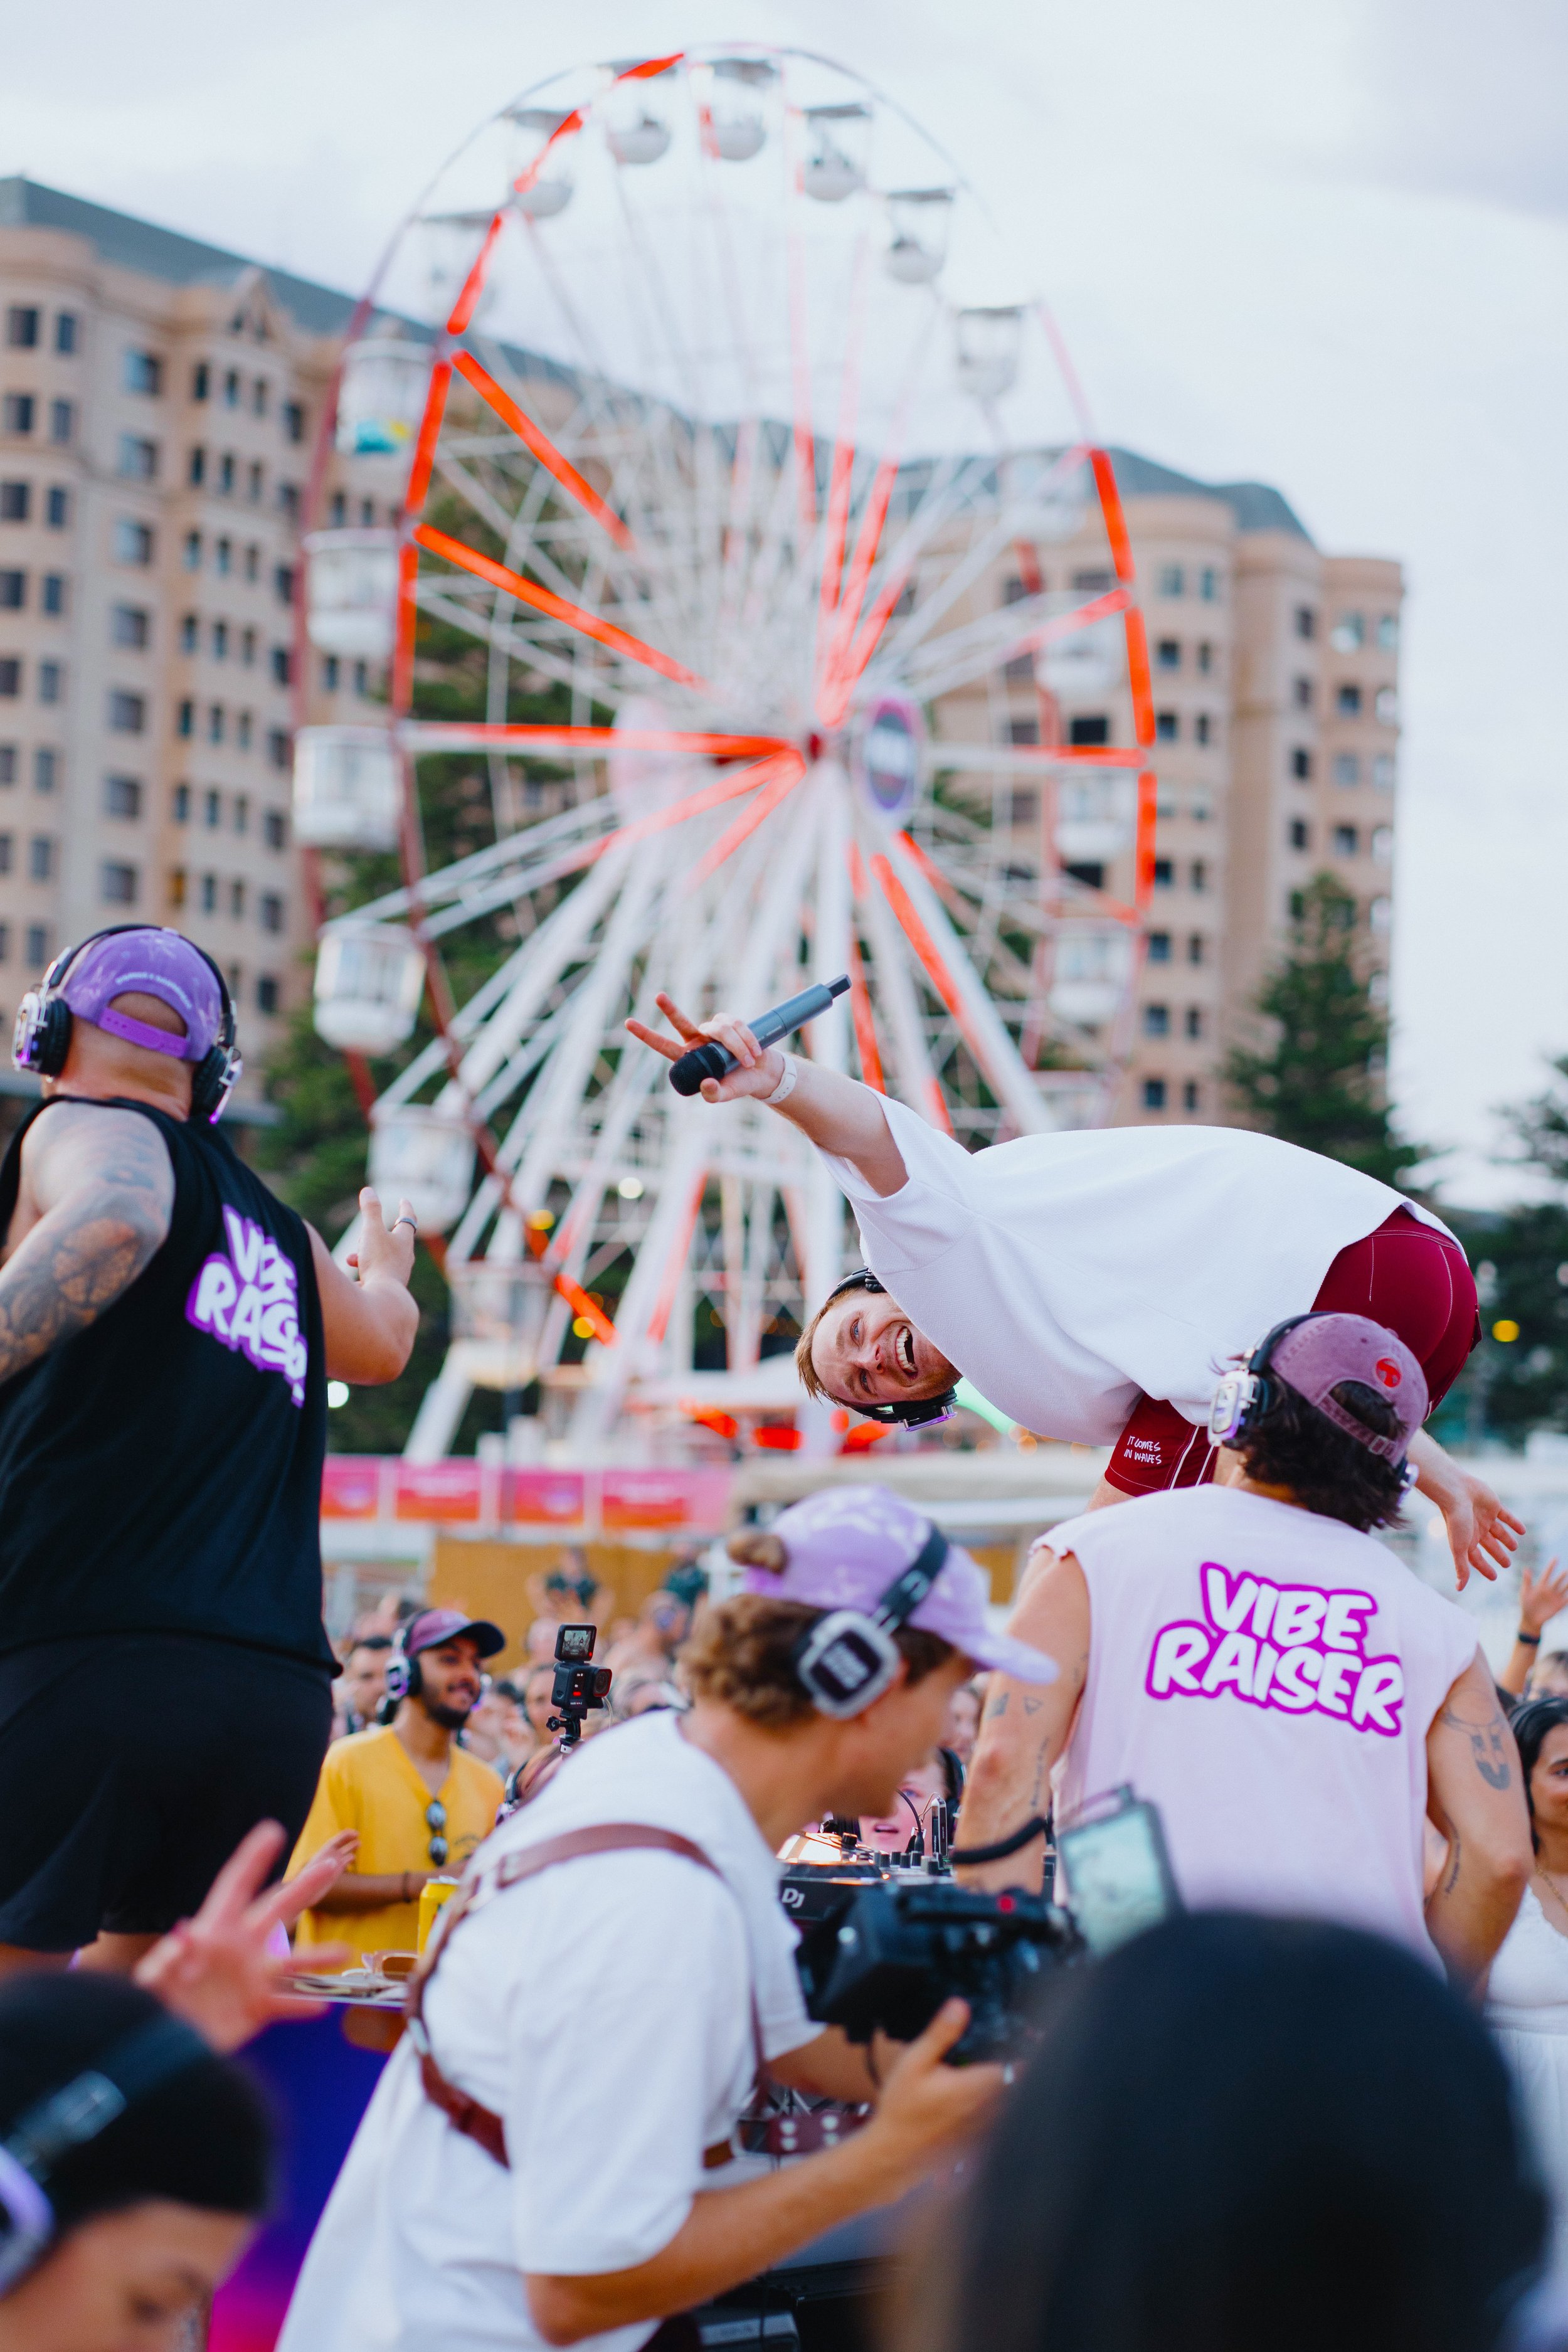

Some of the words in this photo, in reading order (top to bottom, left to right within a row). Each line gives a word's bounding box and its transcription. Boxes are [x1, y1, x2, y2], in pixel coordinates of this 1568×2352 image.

[1127, 1435, 1135, 1446] IT
[1134, 1438, 1161, 1452] COMES
[1123, 1448, 1133, 1459] IN
[1134, 1451, 1162, 1465] WAVES
[1200, 1562, 1377, 1655] VIBE
[1145, 1620, 1404, 1737] RAISER
[781, 1887, 805, 1908] DJ
